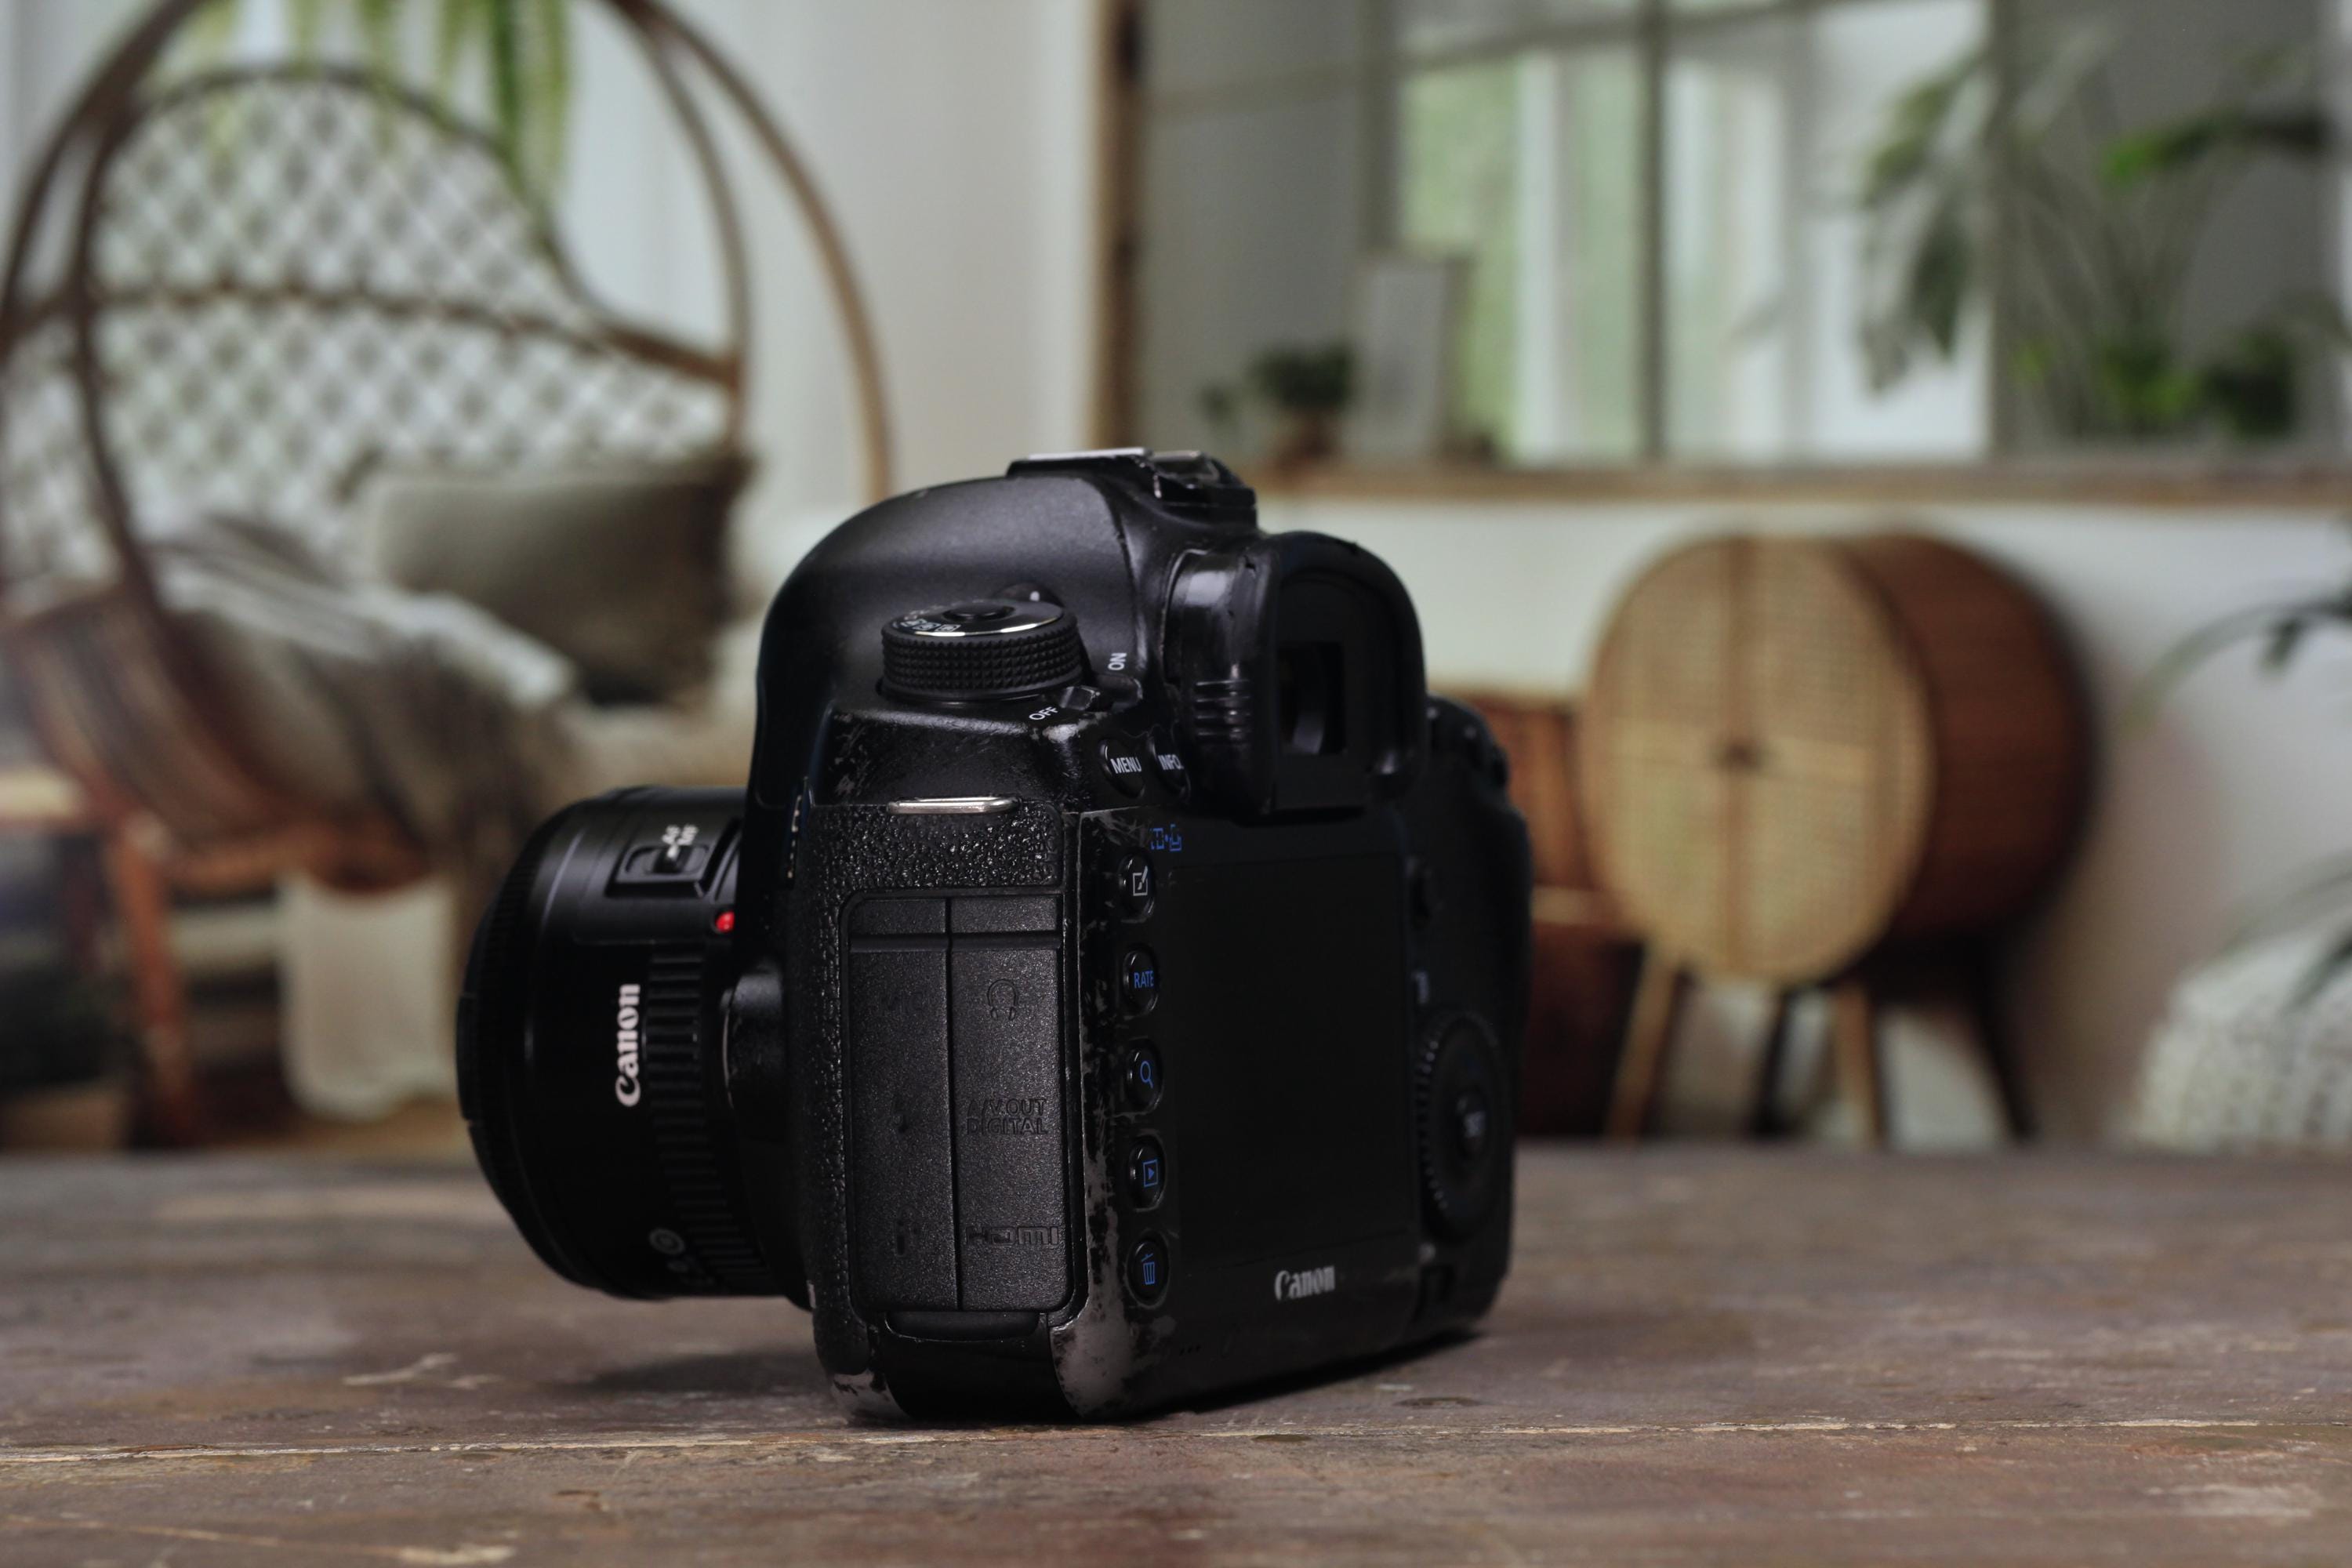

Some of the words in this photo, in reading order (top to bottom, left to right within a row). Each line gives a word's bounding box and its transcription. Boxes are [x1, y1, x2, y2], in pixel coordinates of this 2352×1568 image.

[1108, 652, 1127, 671] ON
[1029, 706, 1058, 720] OFF
[1110, 757, 1142, 774] MENU
[1134, 971, 1153, 989] RATE
[615, 984, 641, 1107] Canon
[967, 1117, 1048, 1134] DIGITAL
[1275, 1265, 1335, 1301] Canon
